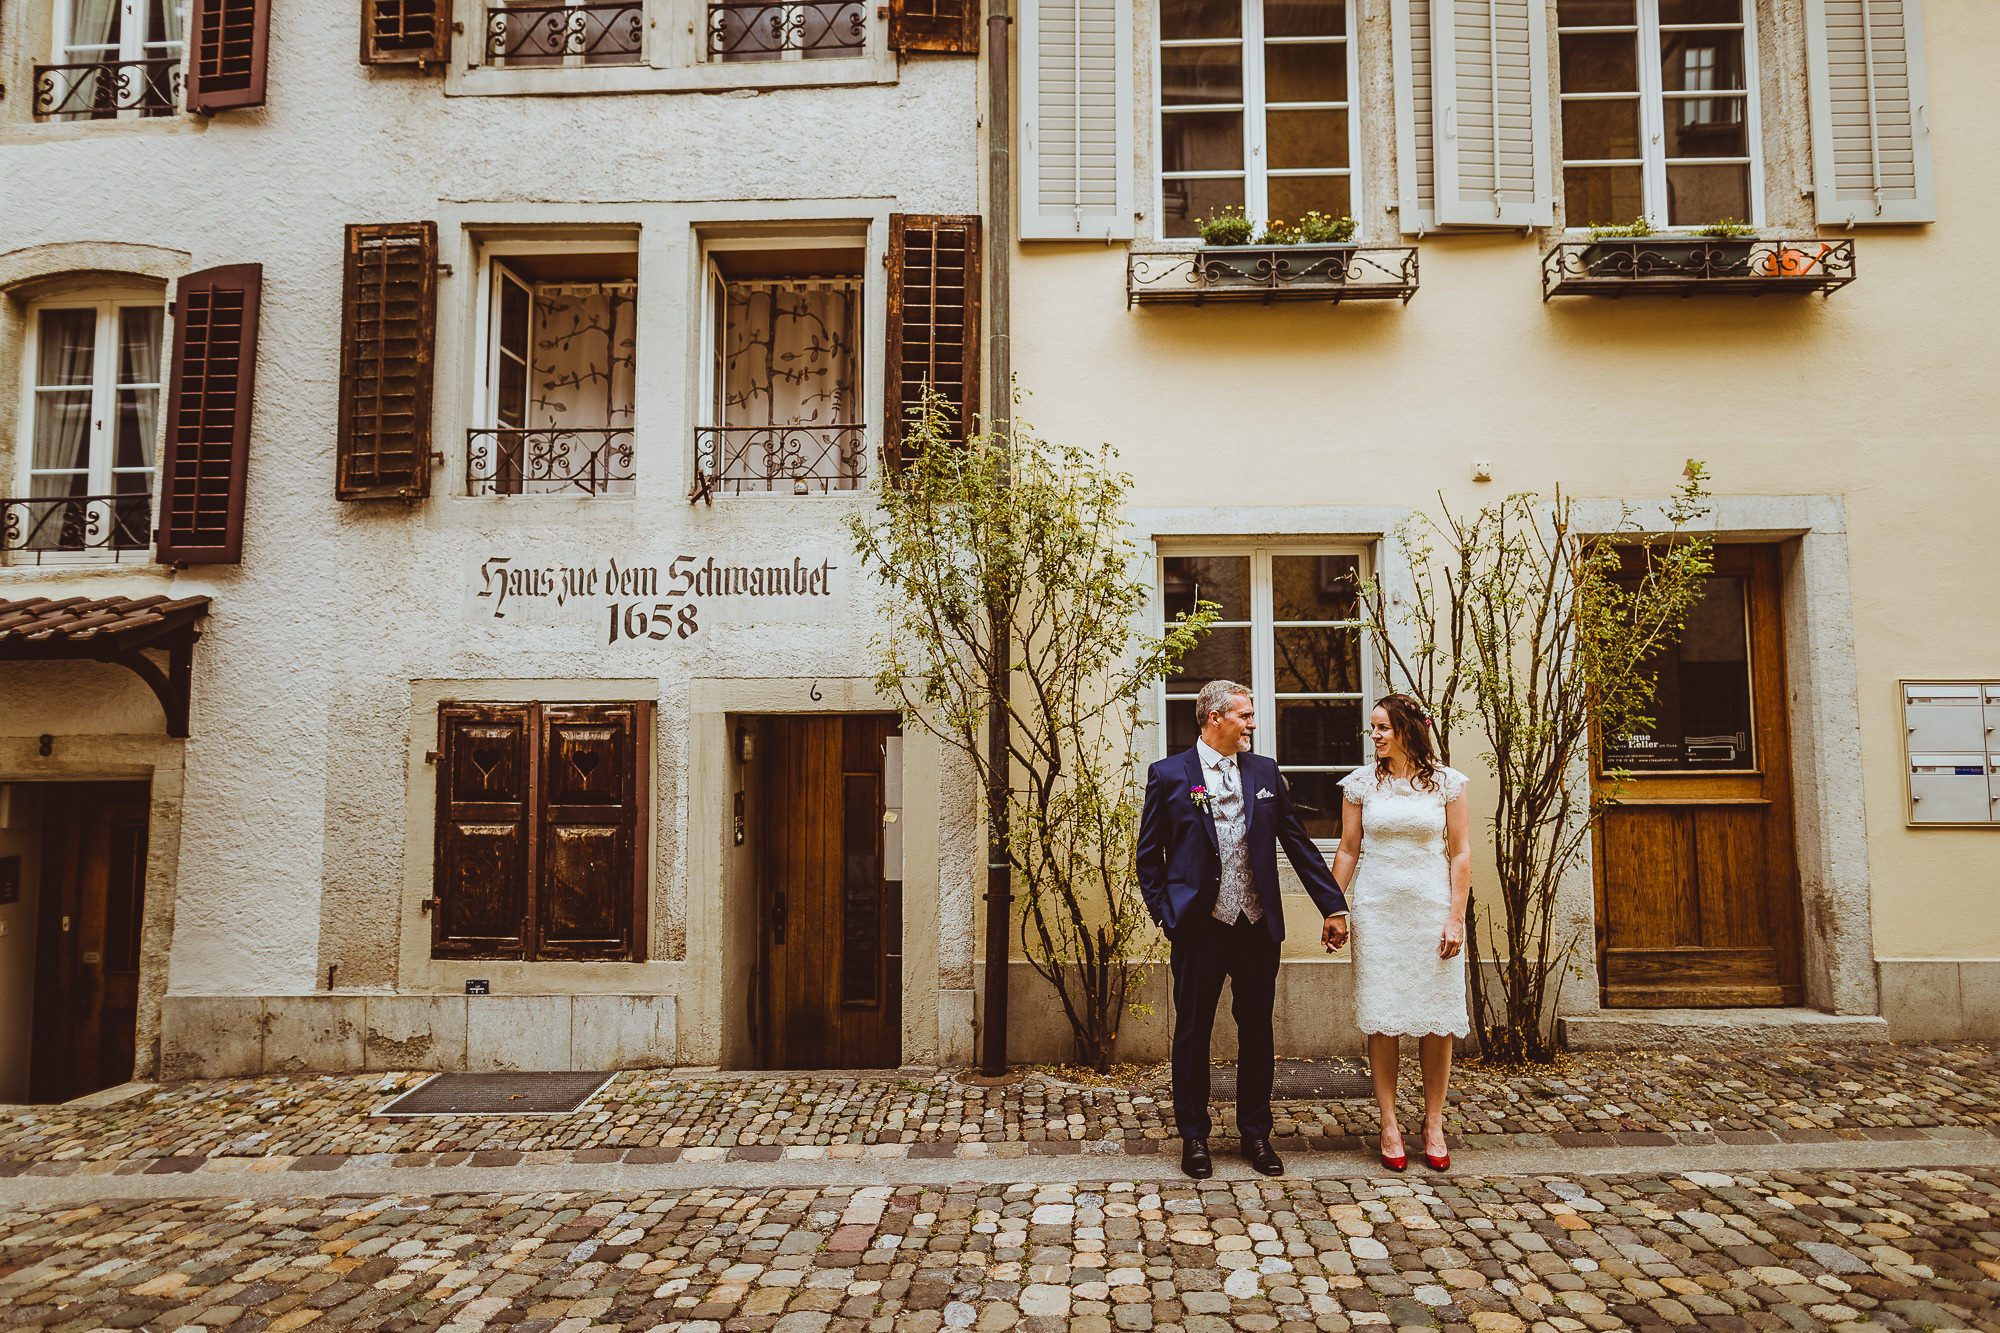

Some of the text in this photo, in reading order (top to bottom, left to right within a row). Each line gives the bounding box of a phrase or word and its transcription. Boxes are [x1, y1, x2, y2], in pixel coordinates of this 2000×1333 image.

[605, 557, 658, 596] dem
[606, 602, 698, 645] 1658
[810, 681, 822, 701] 6
[1628, 740, 1659, 749] Keller
